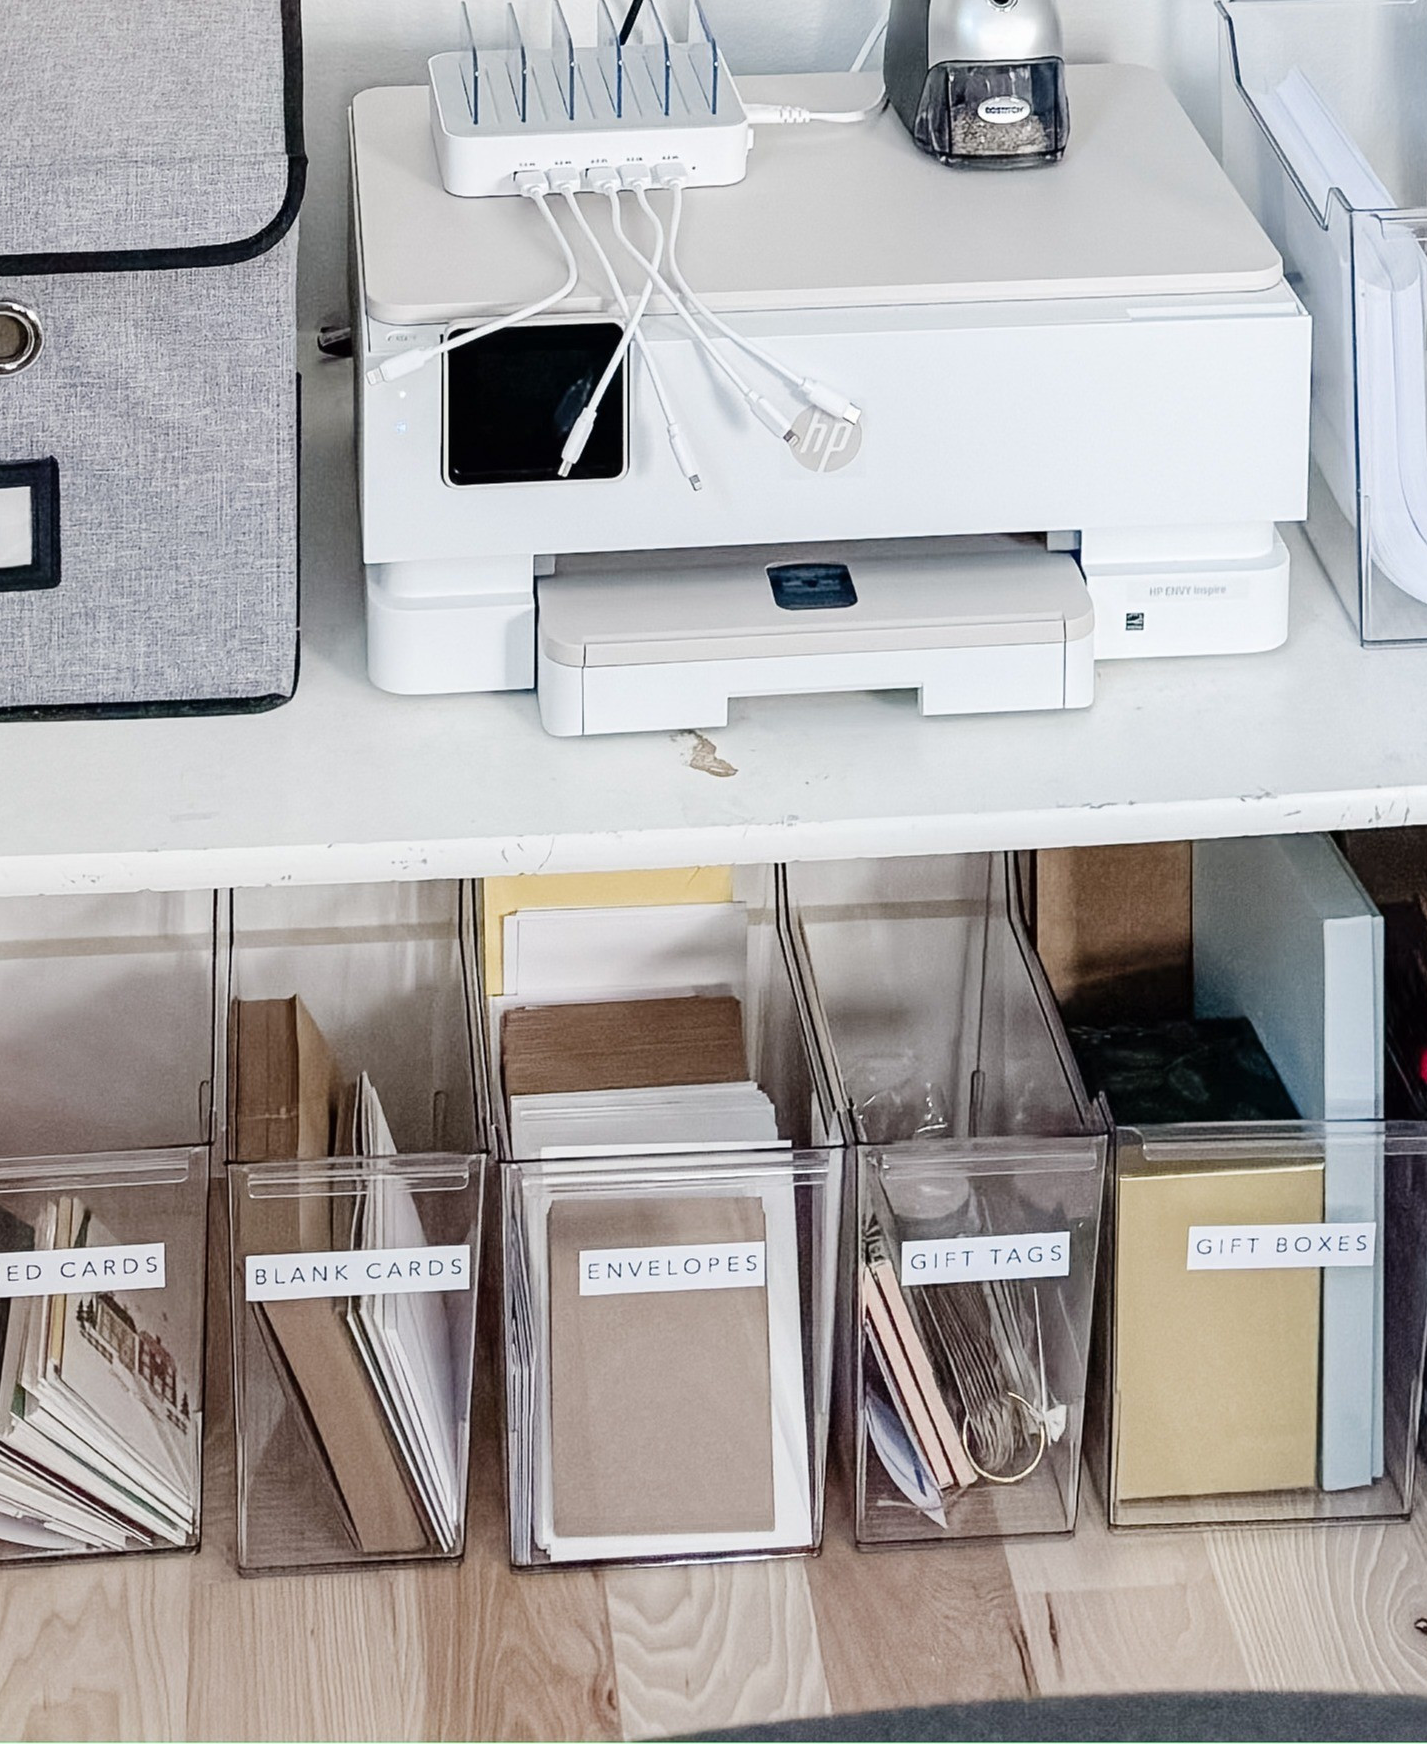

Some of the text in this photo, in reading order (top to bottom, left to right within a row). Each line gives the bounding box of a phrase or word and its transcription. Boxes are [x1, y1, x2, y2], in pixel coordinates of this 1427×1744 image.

[799, 404, 855, 473] hp
[1149, 586, 1163, 597] HP
[1165, 586, 1192, 597] ENVY
[910, 1244, 1062, 1270] GIFT TAGS
[1196, 1234, 1368, 1256] GIFT BOXES
[59, 1256, 158, 1279] CARDS
[255, 1258, 463, 1286] BLANK CARDS
[587, 1254, 758, 1280] ENVELOPES
